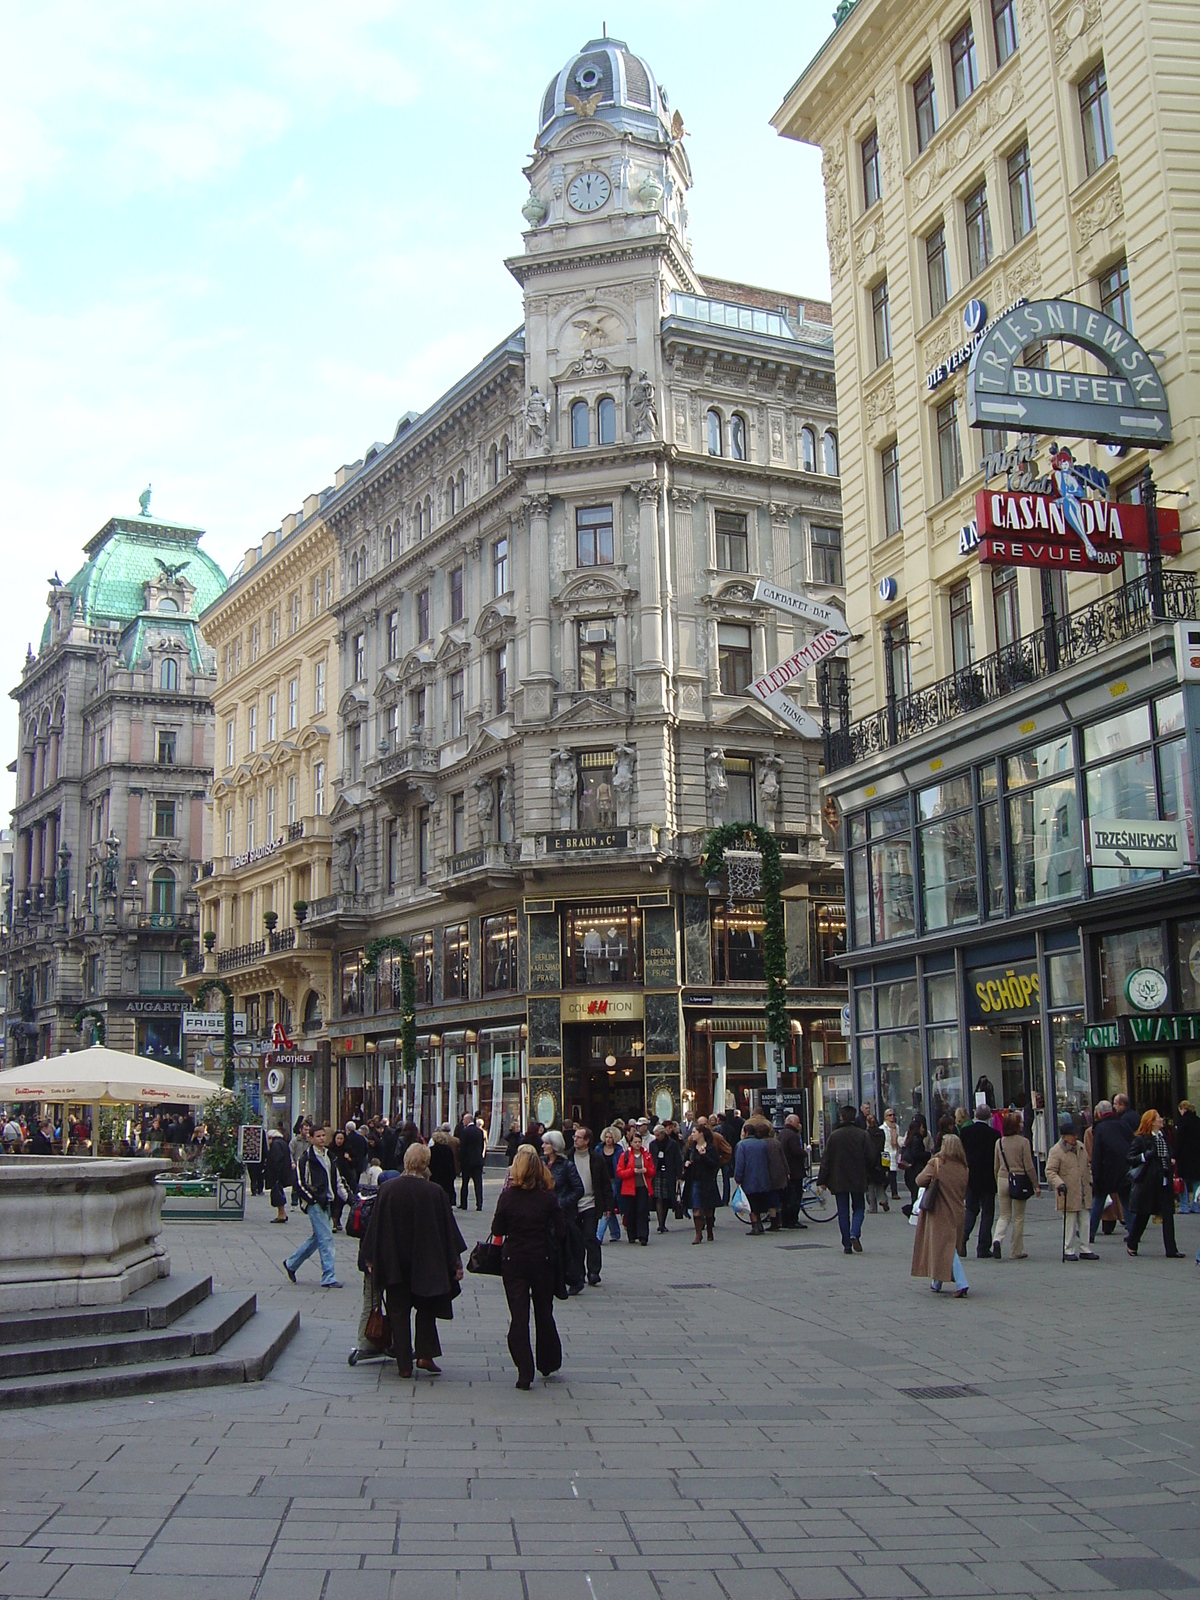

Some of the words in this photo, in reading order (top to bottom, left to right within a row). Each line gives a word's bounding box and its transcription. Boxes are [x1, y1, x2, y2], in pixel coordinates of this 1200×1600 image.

[926, 365, 946, 390] DIE
[1012, 370, 1127, 404] BUFFET
[991, 494, 1123, 540] CASANOVA
[992, 541, 1082, 563] REVUE
[1097, 552, 1118, 566] BAR
[755, 630, 838, 700] FLEDERMAUS
[779, 702, 806, 726] MUSIC
[566, 836, 597, 848] BRAUN
[1095, 830, 1177, 849] TRZEŚNIEWSKI
[535, 953, 555, 962] BERLIN
[650, 949, 671, 957] BERLIN
[531, 963, 560, 972] KARLSBAD
[645, 958, 676, 967] KARLSBAD
[536, 974, 555, 982] PRAG
[651, 969, 670, 977] PRAG
[186, 1019, 244, 1028] FRISER
[276, 1055, 312, 1063] APOTHEKE
